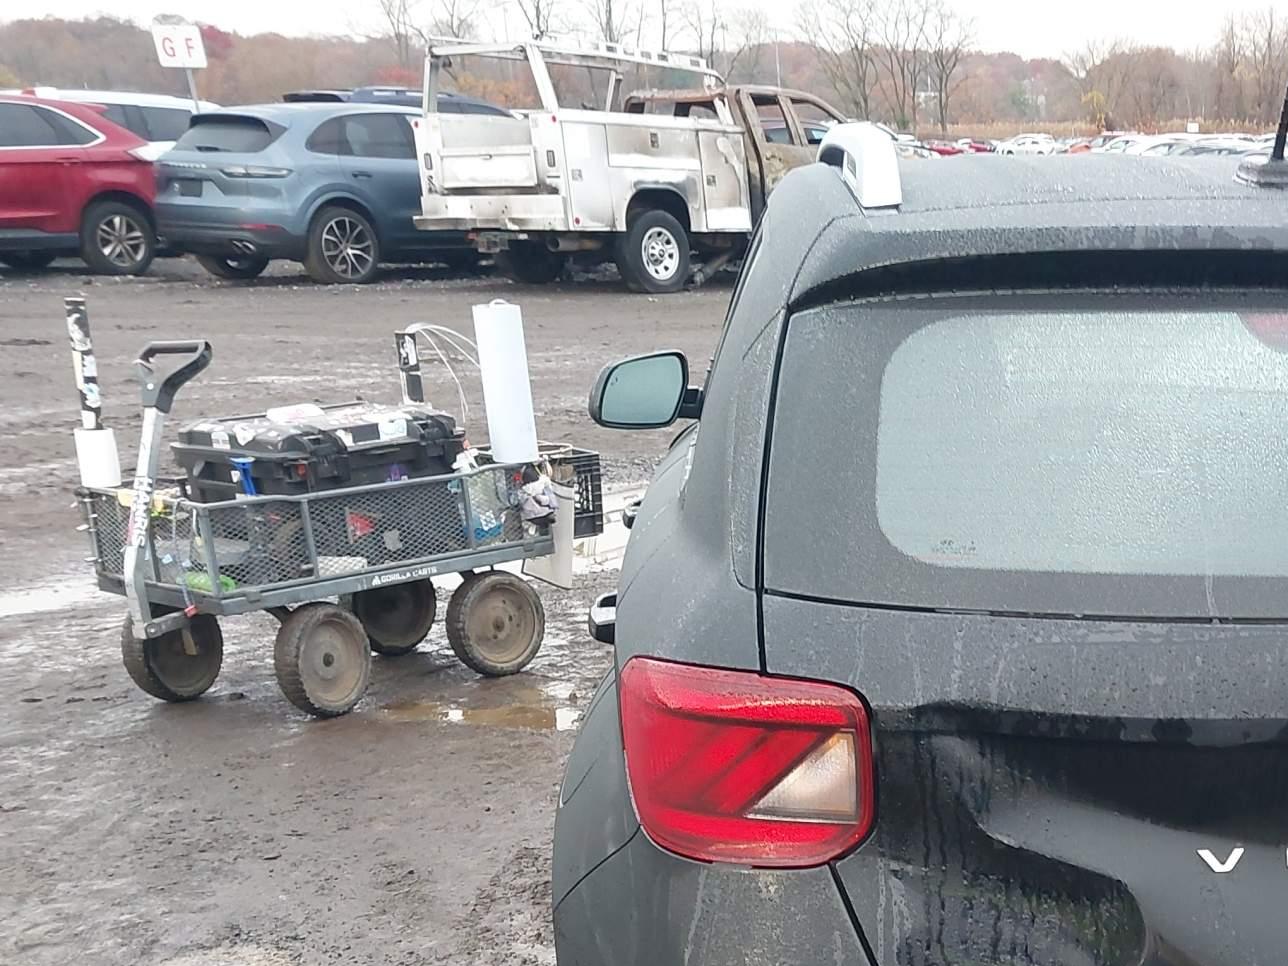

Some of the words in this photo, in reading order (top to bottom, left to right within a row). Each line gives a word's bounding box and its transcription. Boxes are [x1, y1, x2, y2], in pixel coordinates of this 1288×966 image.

[162, 37, 176, 57] G
[185, 37, 194, 58] F
[381, 571, 411, 583] GORILLA
